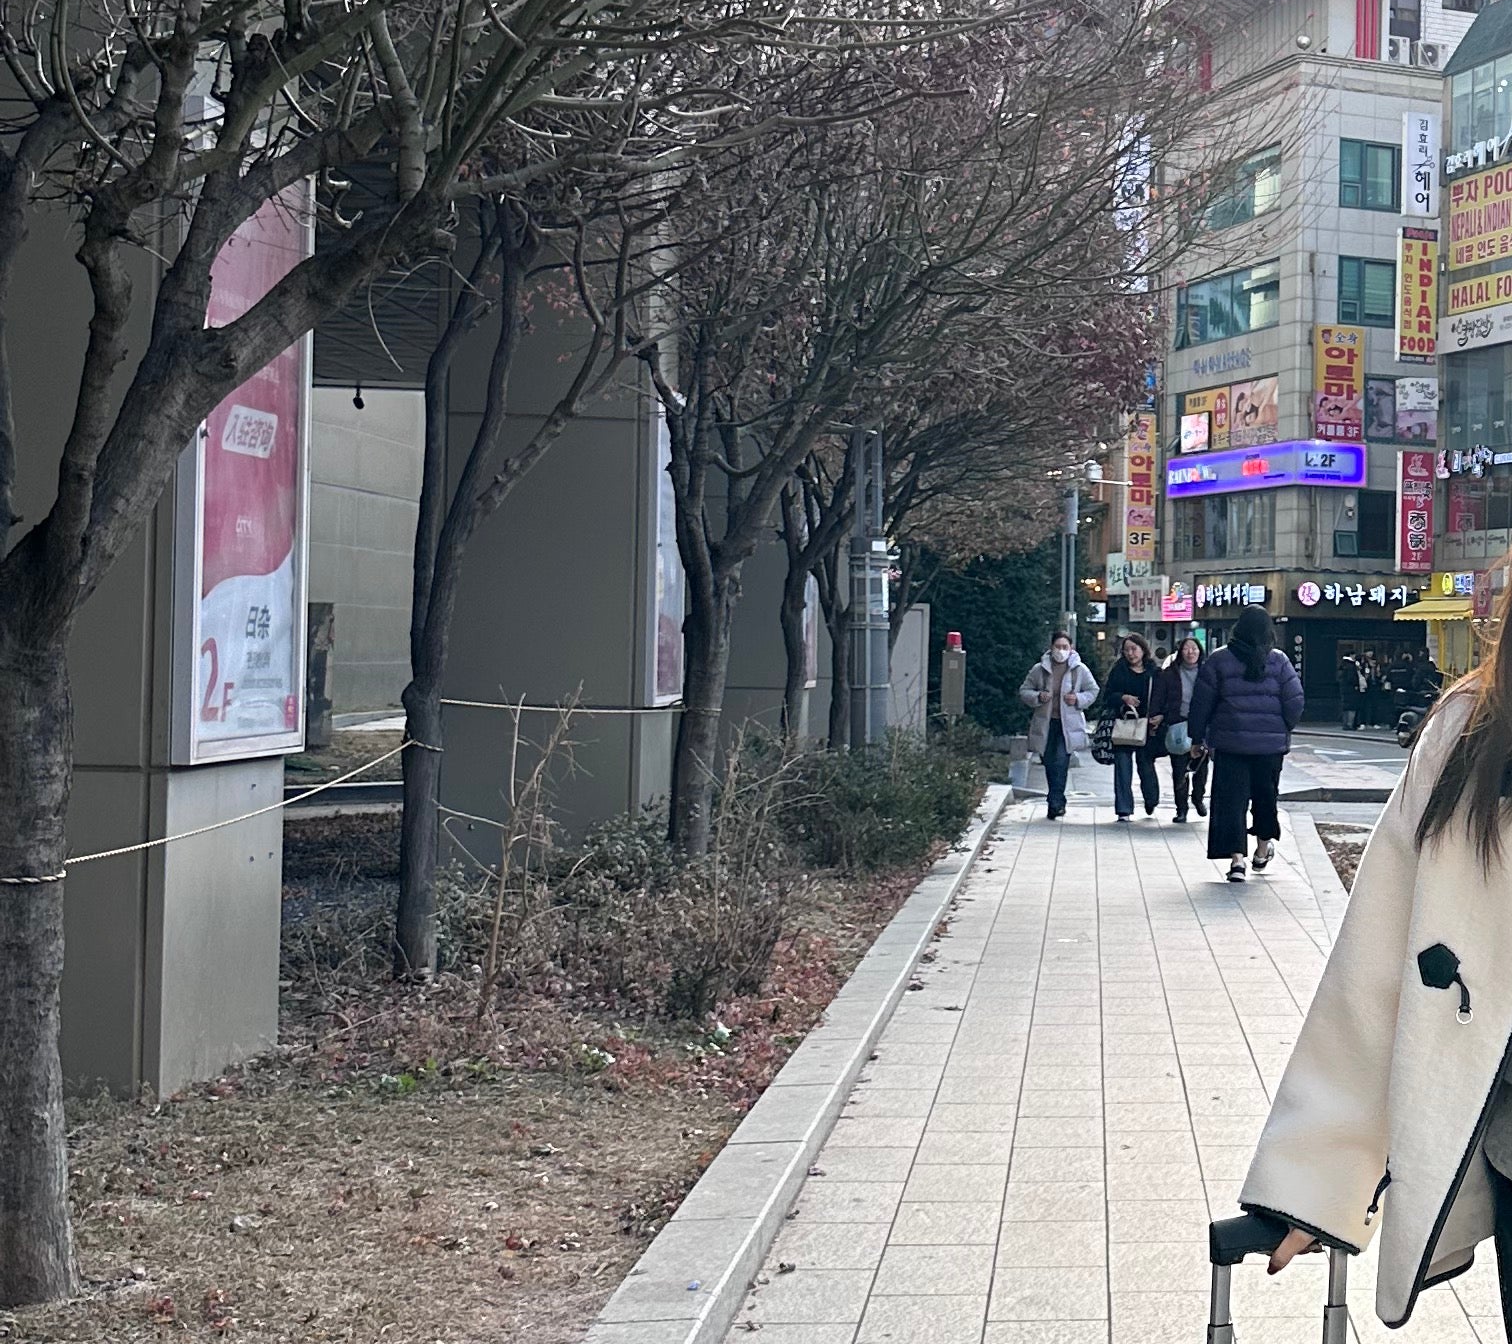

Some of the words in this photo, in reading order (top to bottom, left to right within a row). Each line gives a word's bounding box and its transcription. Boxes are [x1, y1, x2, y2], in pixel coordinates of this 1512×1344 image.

[1418, 118, 1429, 157] 김효리
[1415, 171, 1430, 212] 헤어
[1477, 237, 1496, 260] 인도
[1416, 242, 1432, 334] INDIAN
[1452, 280, 1491, 309] HALAL
[1400, 336, 1436, 353] FOOD
[1347, 425, 1360, 437] 3F
[1320, 453, 1336, 468] 2F
[1129, 532, 1152, 545] 3F
[1324, 583, 1409, 606] 하남돼지
[246, 605, 271, 640] 日杂
[201, 637, 235, 722] 2F
